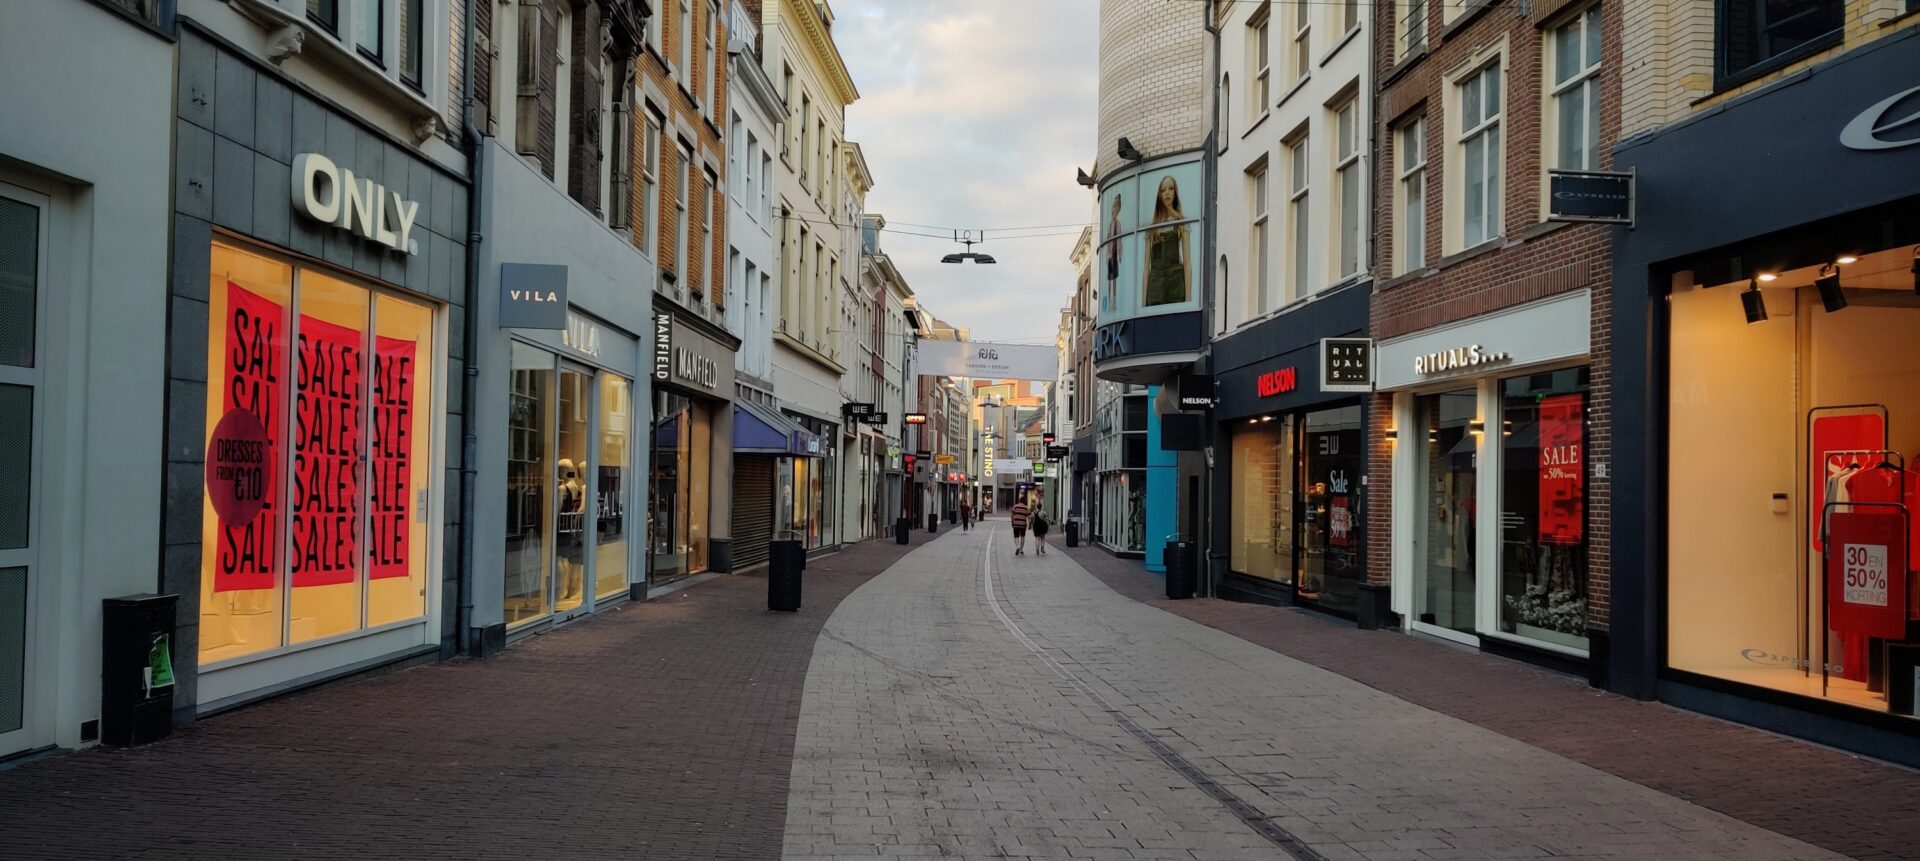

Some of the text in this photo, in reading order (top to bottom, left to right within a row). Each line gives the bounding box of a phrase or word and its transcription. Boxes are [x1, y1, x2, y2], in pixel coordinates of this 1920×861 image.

[511, 290, 558, 302] VILA
[657, 314, 669, 380] MANFIELD
[678, 346, 718, 390] MANFIELD
[1257, 366, 1296, 398] NELSON
[852, 405, 868, 414] WE
[217, 438, 263, 464] DRESSES
[984, 447, 994, 477] STING
[1543, 445, 1579, 466] SALE
[216, 466, 262, 501] FROM €10
[1330, 469, 1349, 493] Sale
[1549, 468, 1564, 479] 50%
[1847, 546, 1883, 568] 30 EN
[1847, 568, 1885, 590] 50%
[1847, 589, 1886, 604] KORTING
